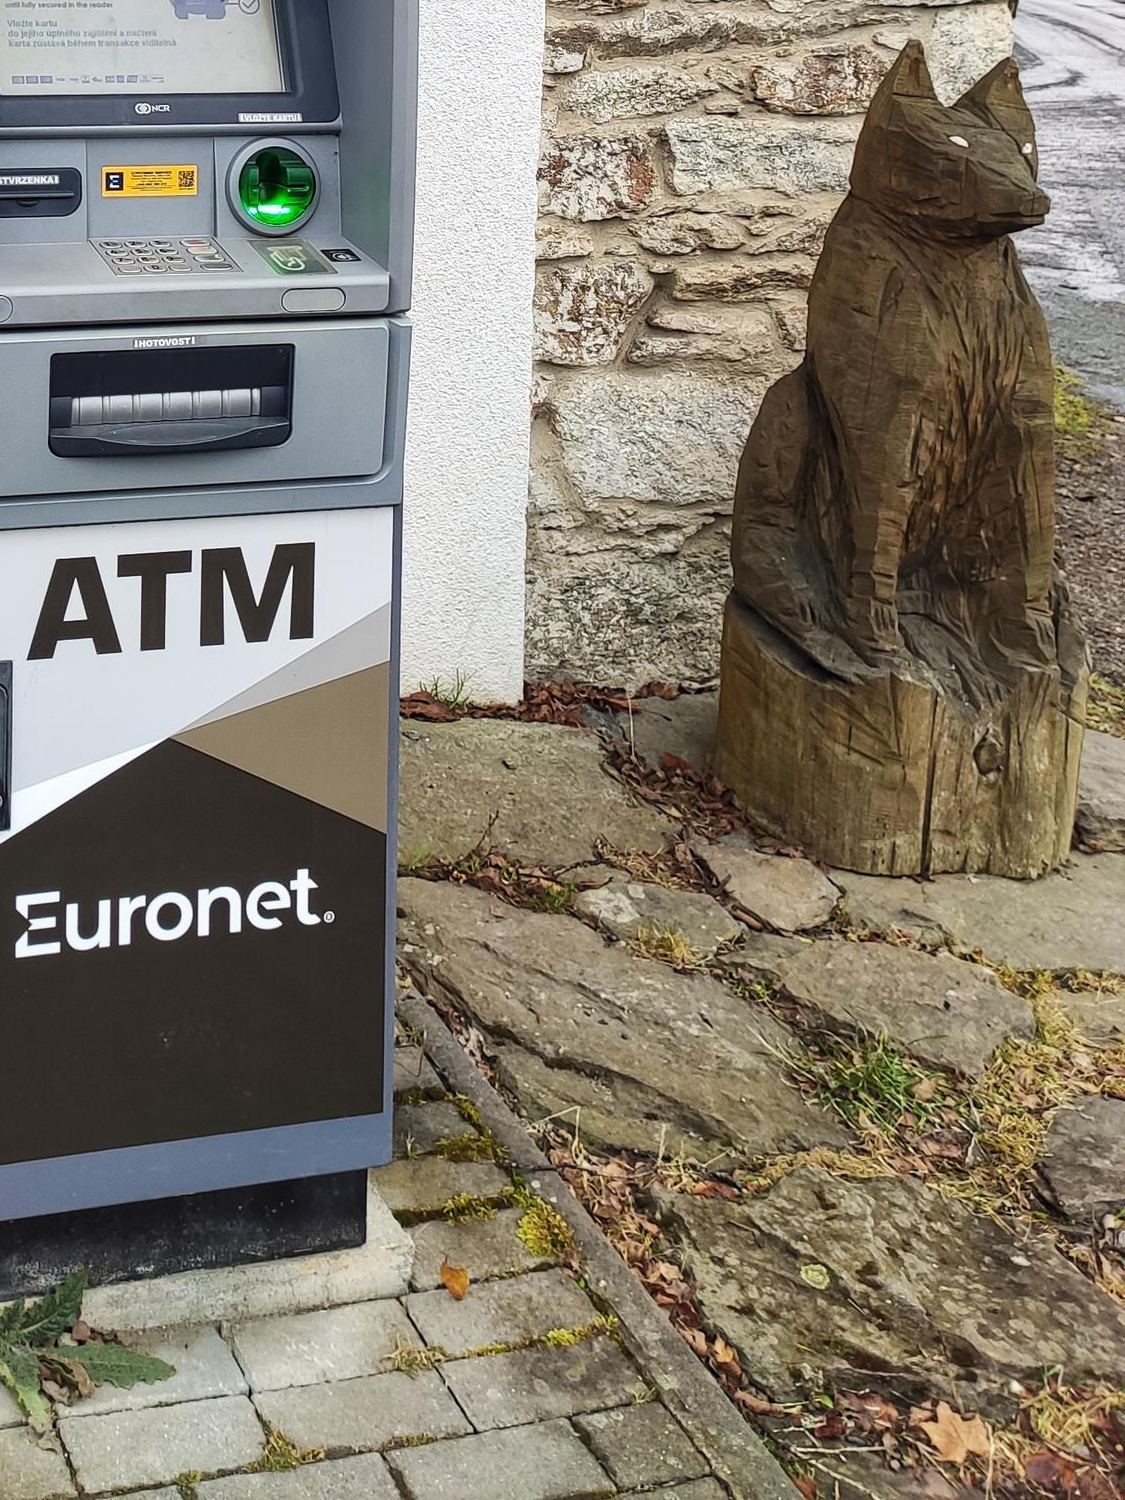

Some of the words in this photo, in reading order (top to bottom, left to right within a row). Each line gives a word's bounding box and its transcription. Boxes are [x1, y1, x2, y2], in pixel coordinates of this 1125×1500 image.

[152, 104, 170, 112] NCR
[26, 542, 316, 661] ATM
[15, 868, 323, 958] Euronet
